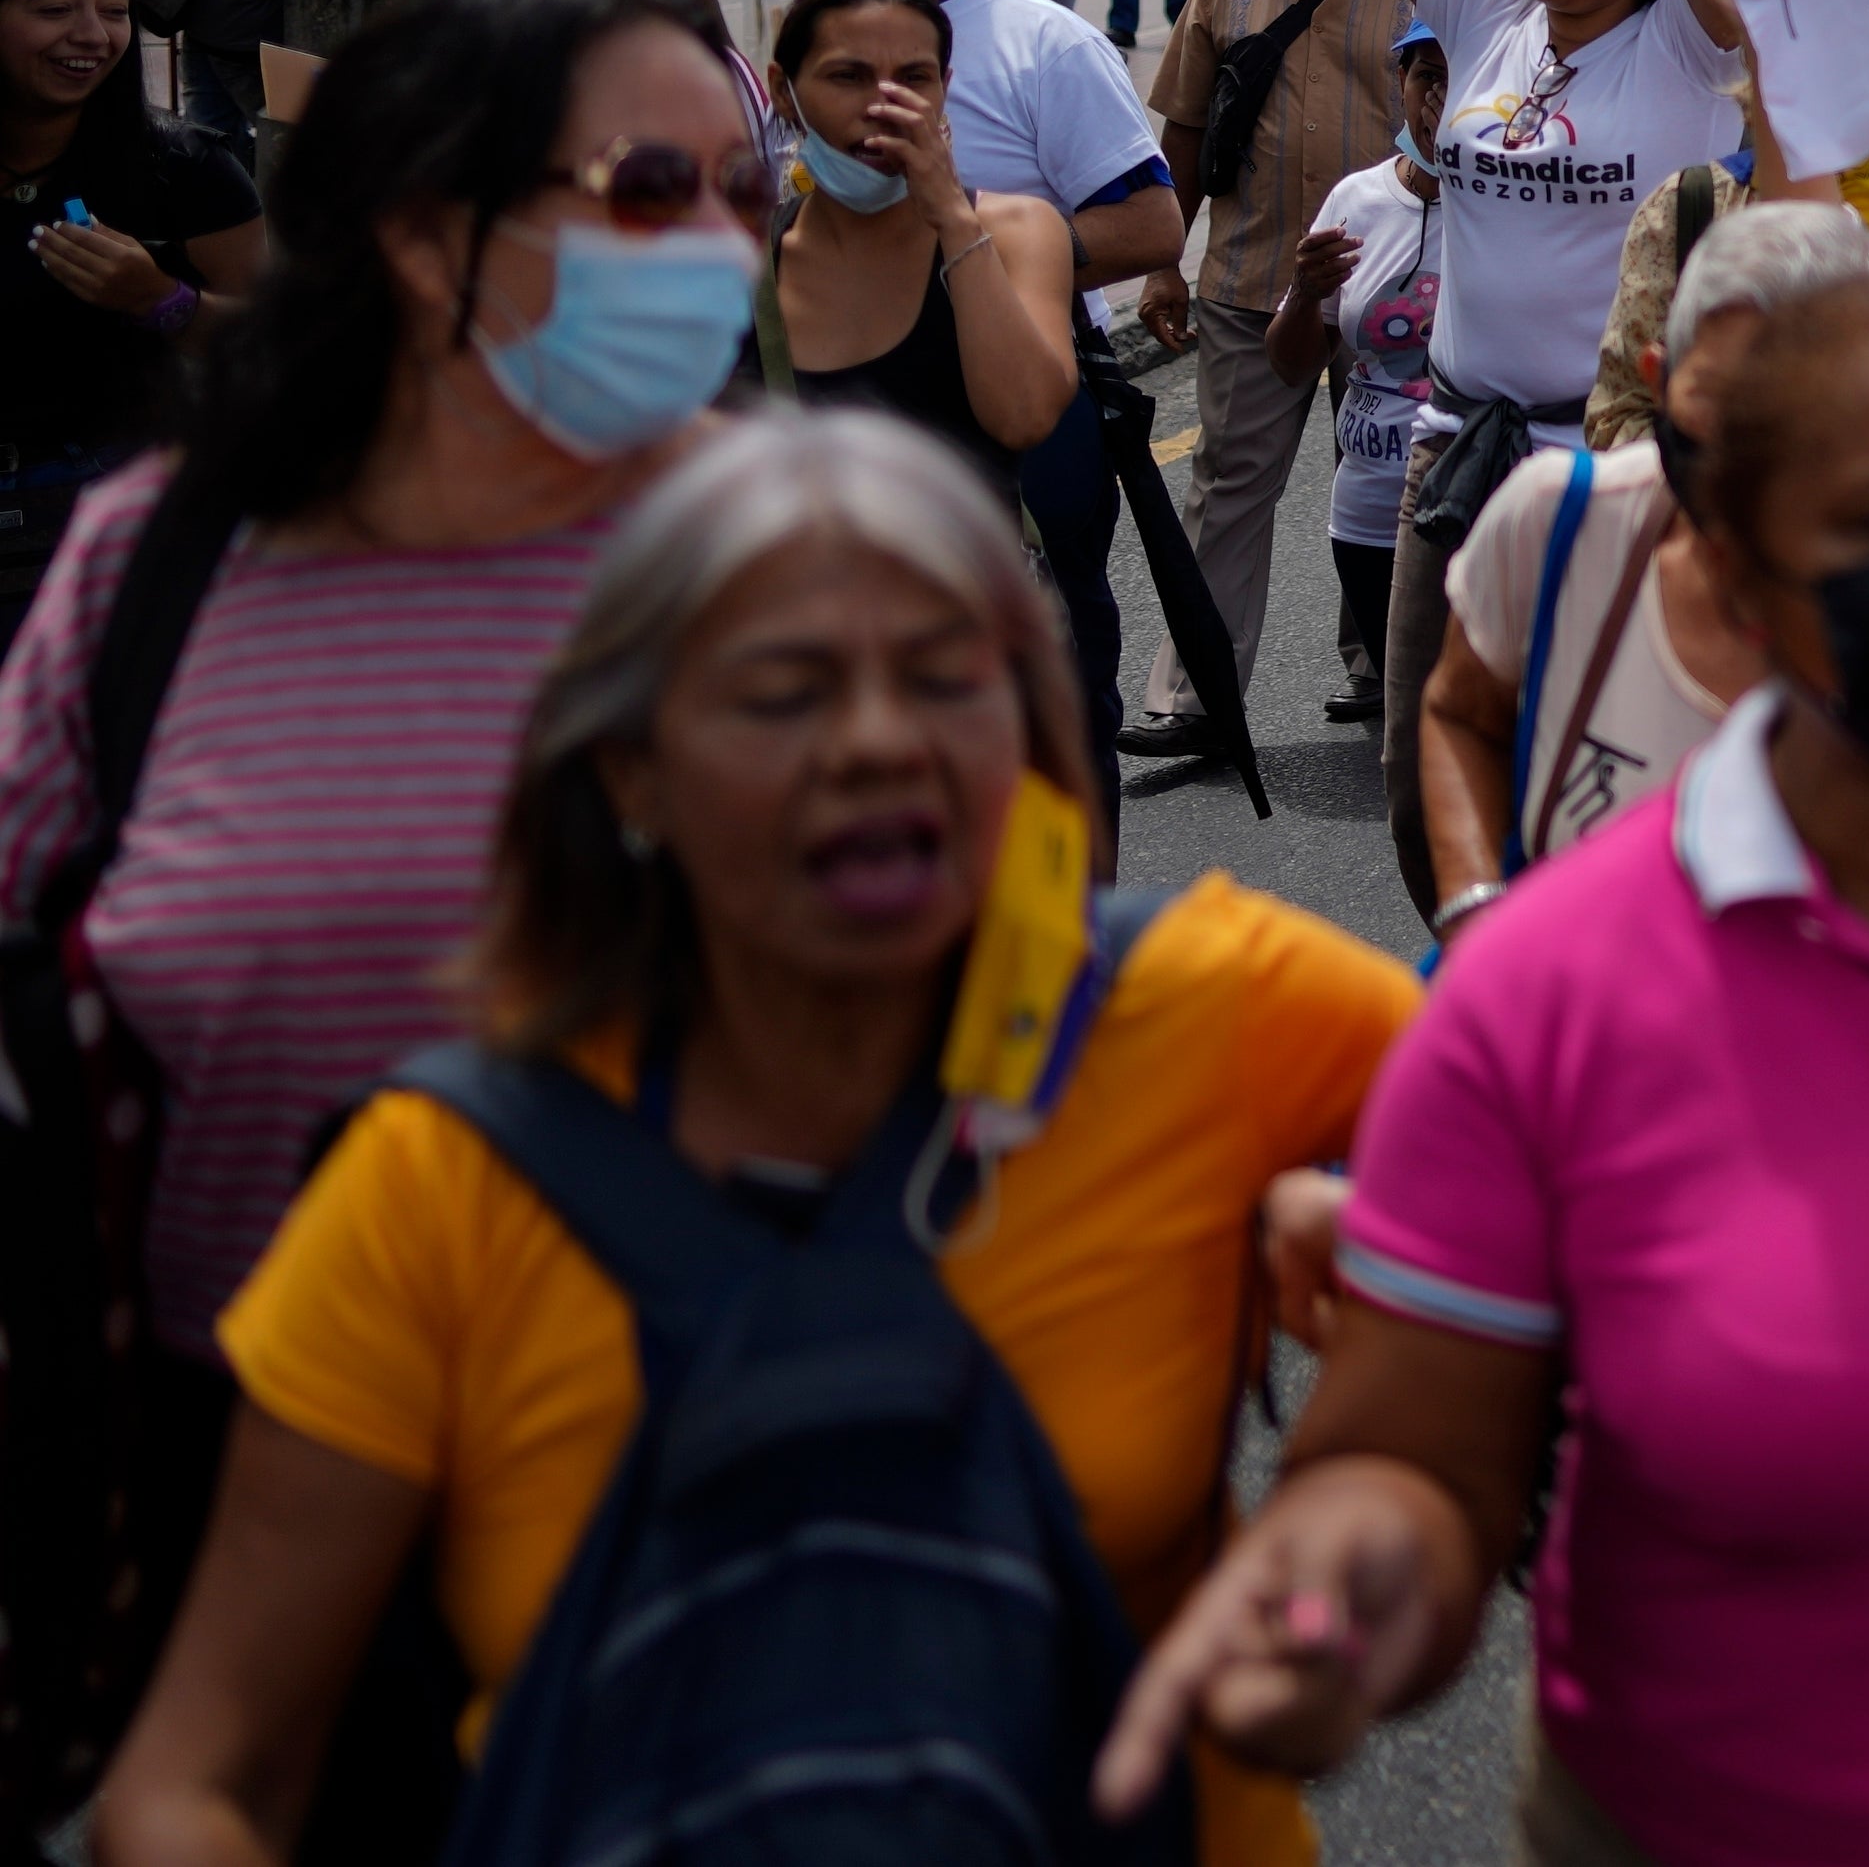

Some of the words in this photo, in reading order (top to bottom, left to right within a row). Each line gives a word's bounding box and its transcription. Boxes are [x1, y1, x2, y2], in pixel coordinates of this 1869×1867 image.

[1434, 143, 1460, 170] ed
[1475, 149, 1635, 185] Sindical
[1439, 170, 1635, 205] nezolana
[1338, 408, 1409, 462] TRABA
